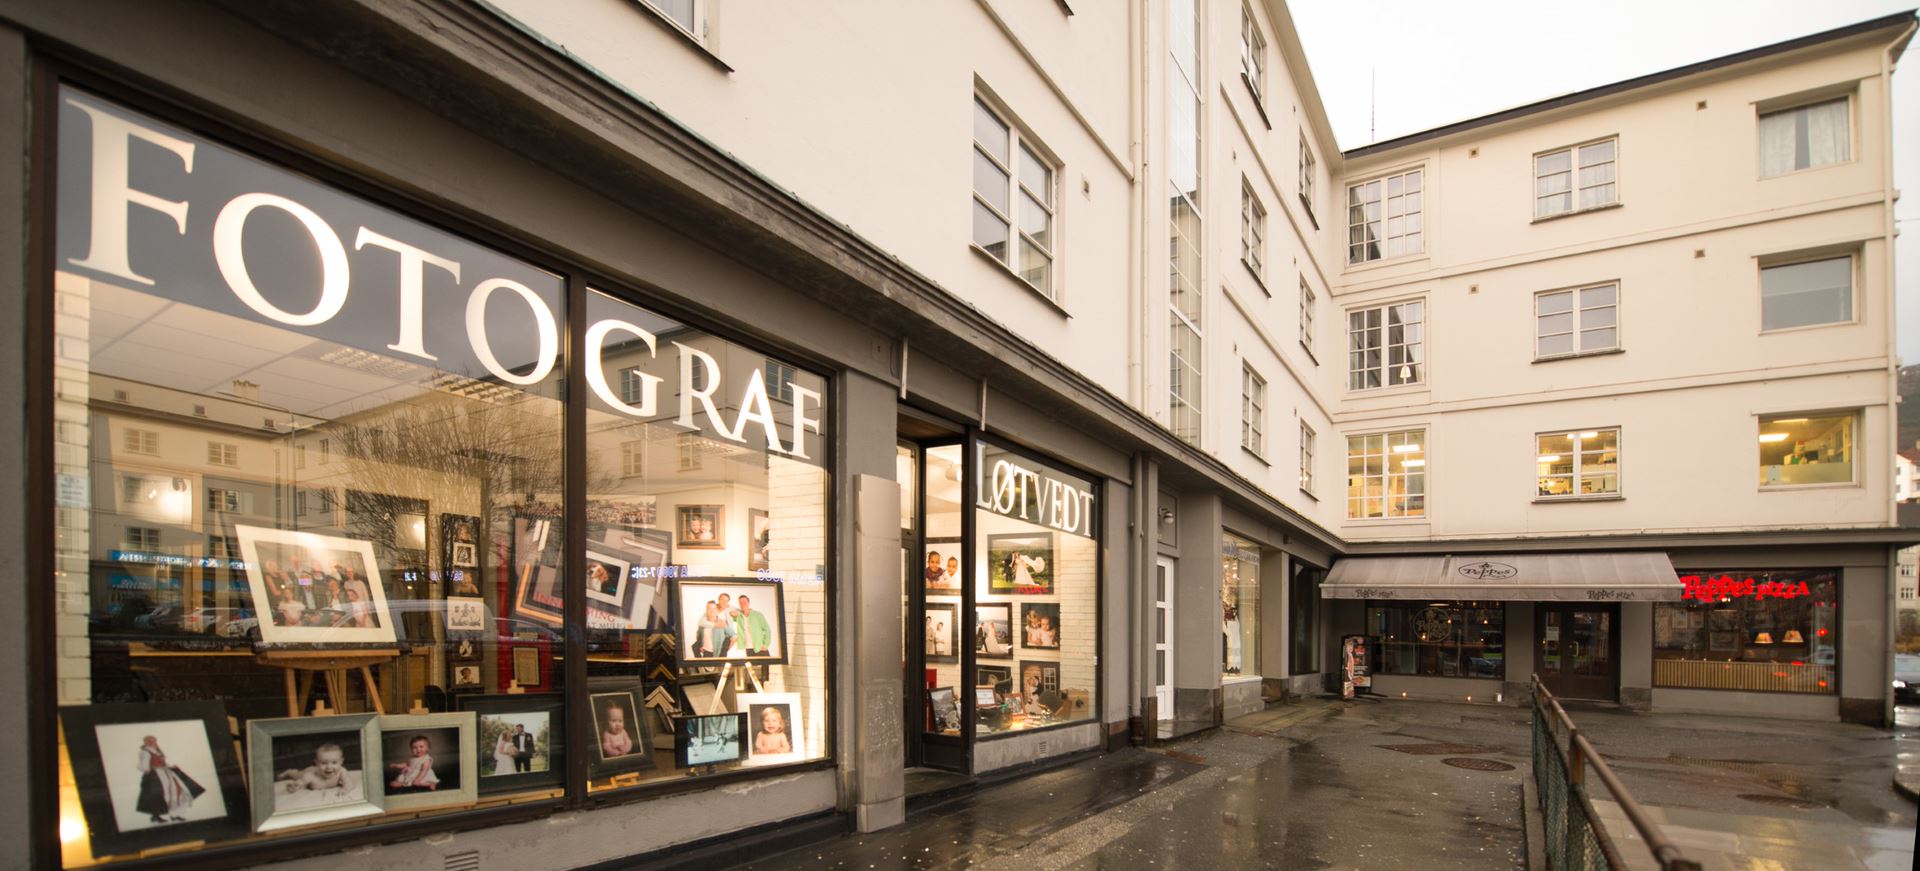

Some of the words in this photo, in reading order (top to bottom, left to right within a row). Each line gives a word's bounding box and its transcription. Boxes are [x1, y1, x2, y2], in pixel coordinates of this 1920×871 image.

[65, 98, 821, 459] FOTOGRAF
[976, 442, 1094, 537] LØTVEDT
[1463, 568, 1511, 579] Peppes
[1587, 589, 1615, 600] Peppes
[1680, 575, 1755, 602] Peppes
